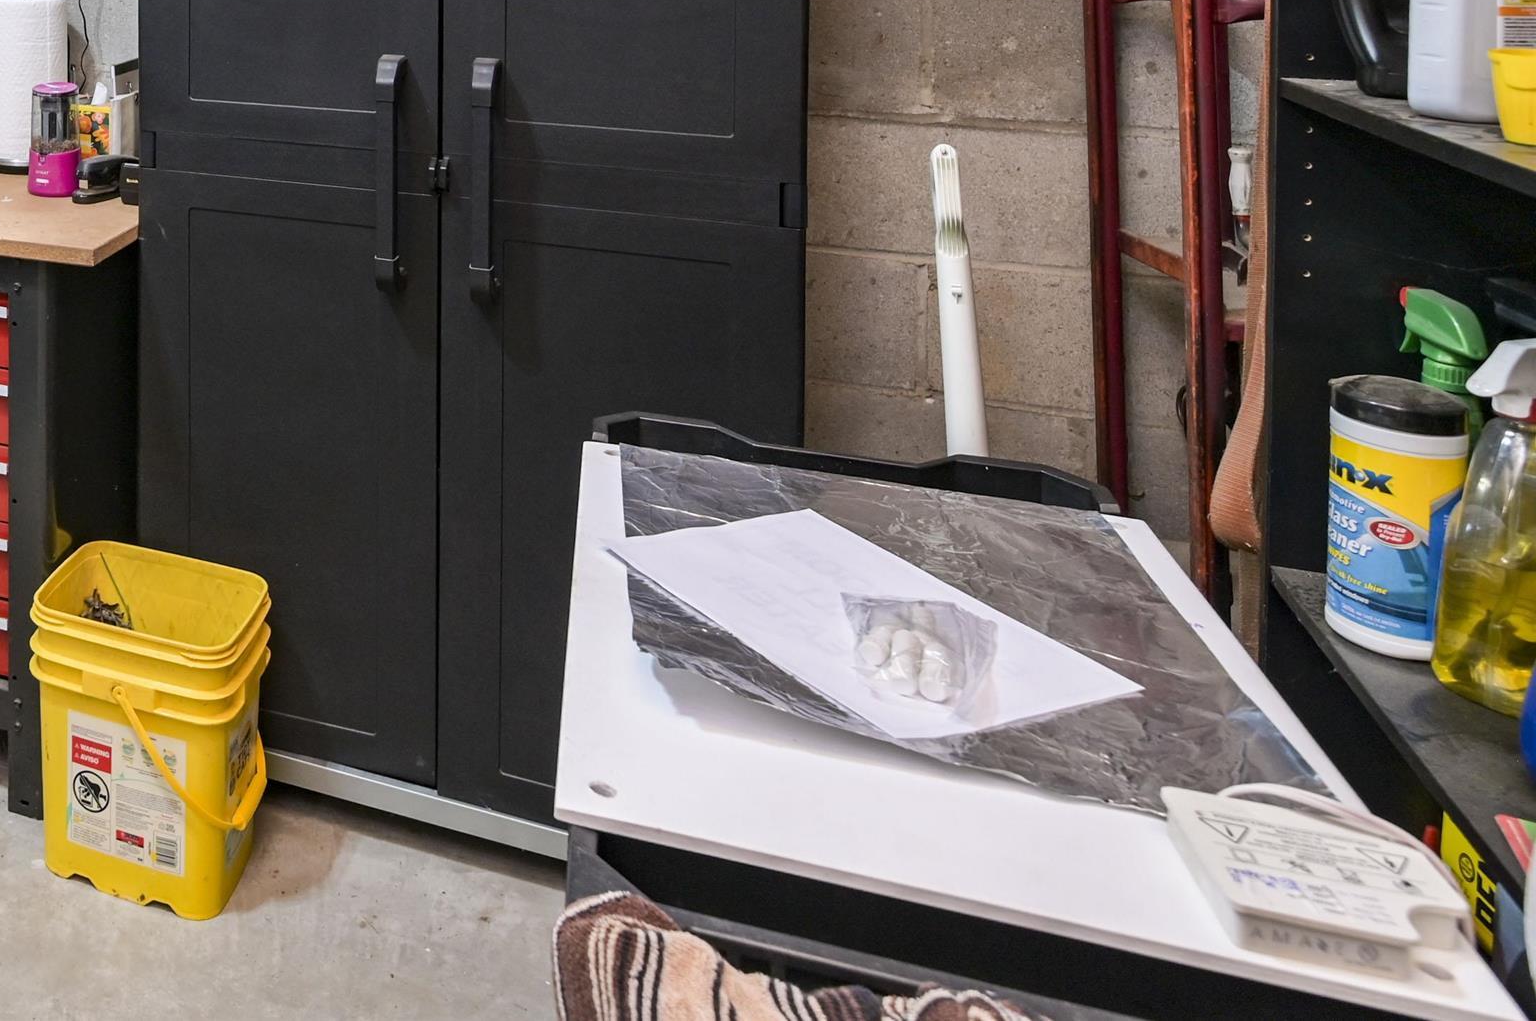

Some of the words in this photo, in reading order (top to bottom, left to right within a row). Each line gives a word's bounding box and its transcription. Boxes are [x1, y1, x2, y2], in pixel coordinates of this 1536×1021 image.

[1328, 525, 1372, 557] aner
[80, 744, 110, 758] WARNING
[80, 754, 99, 765] AVISO
